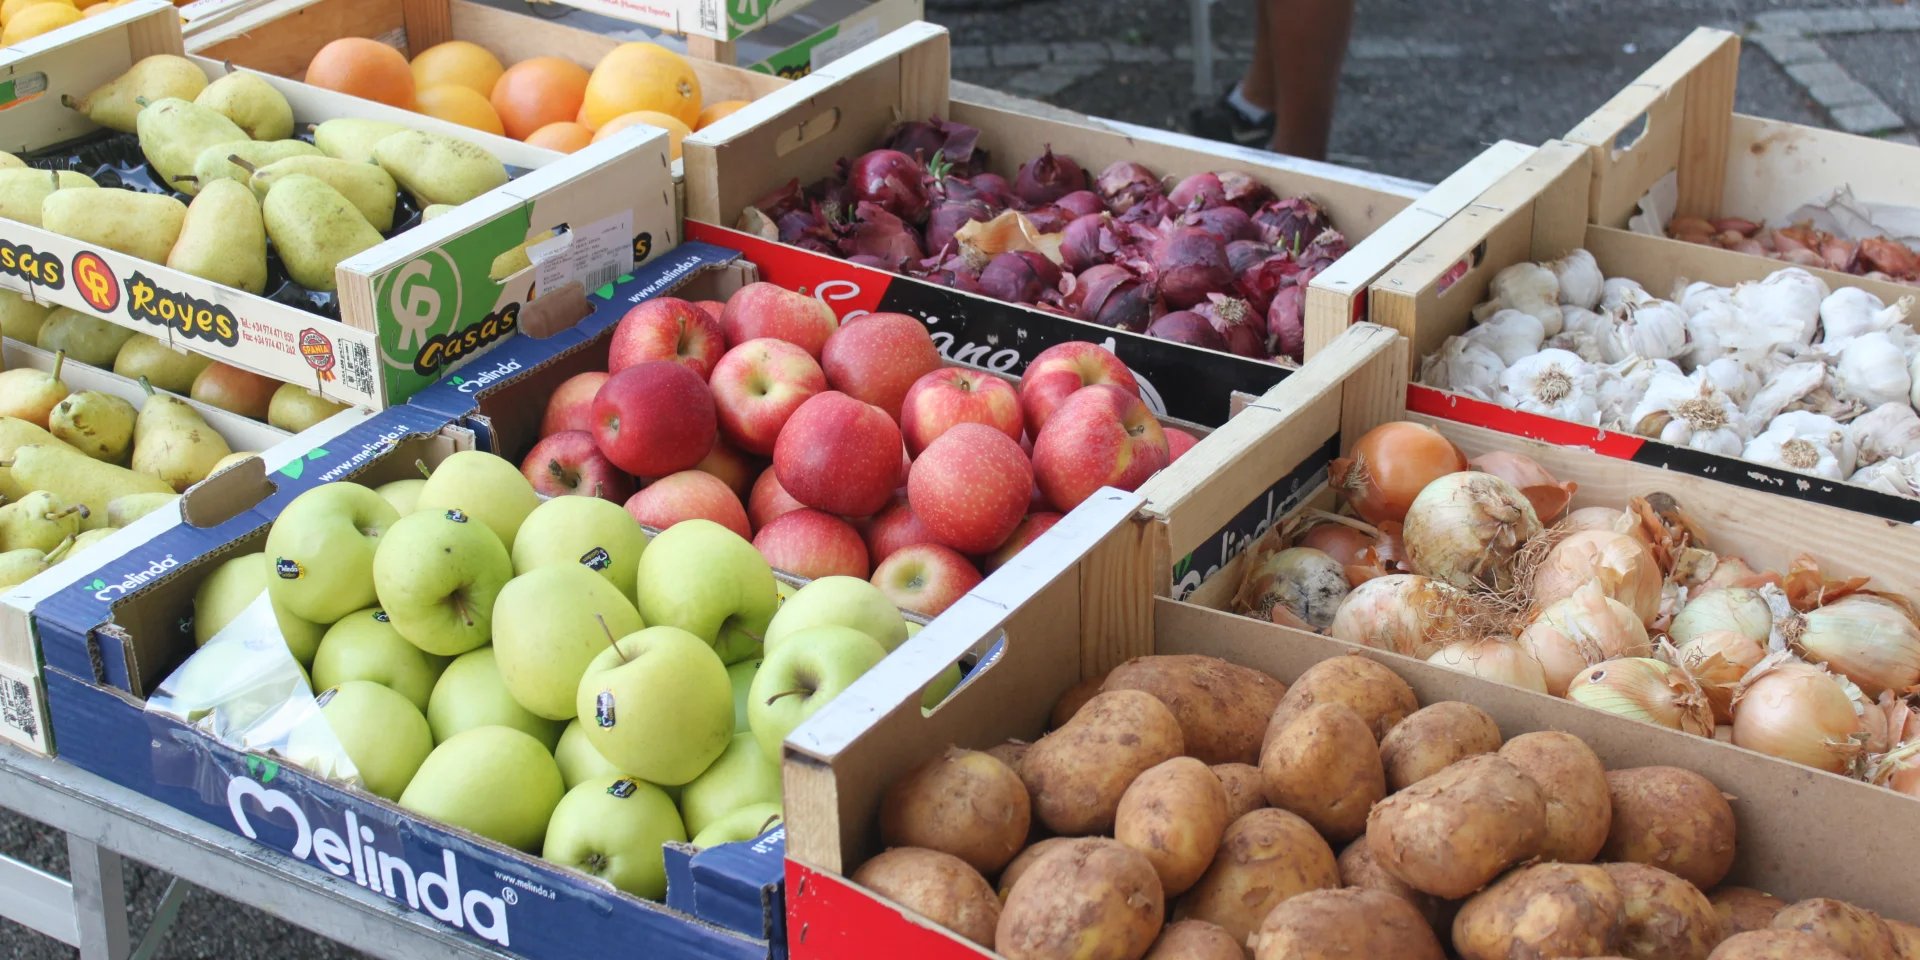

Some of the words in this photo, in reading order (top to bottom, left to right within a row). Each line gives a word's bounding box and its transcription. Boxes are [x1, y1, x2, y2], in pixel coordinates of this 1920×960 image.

[0, 247, 59, 283] sas
[628, 255, 702, 303] www.melinda.it
[132, 280, 233, 339] Royes
[420, 310, 515, 358] Casas
[318, 424, 410, 481] www.melinda.it
[494, 870, 556, 900] www.melinda.it
